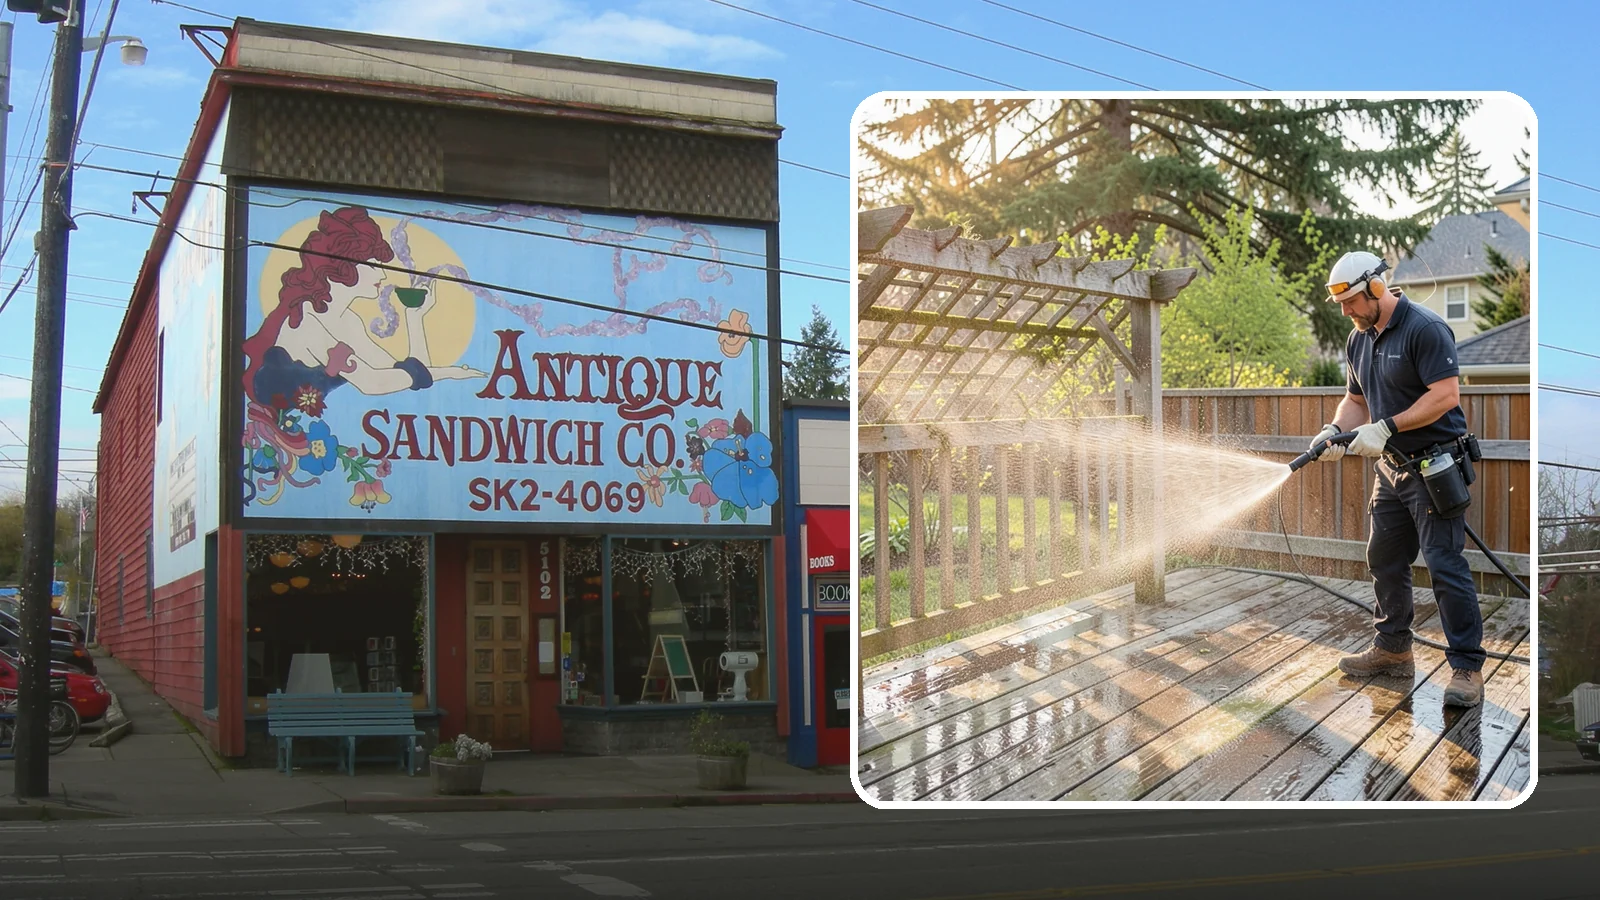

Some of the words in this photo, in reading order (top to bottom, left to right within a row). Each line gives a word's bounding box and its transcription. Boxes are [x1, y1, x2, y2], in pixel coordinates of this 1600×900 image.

[475, 328, 724, 421] ANTIQUE
[361, 408, 604, 467] SANDWICH
[617, 422, 685, 468] CO.
[468, 477, 646, 513] SK2-4069
[539, 541, 551, 600] 5102
[809, 555, 835, 569] BOOKS
